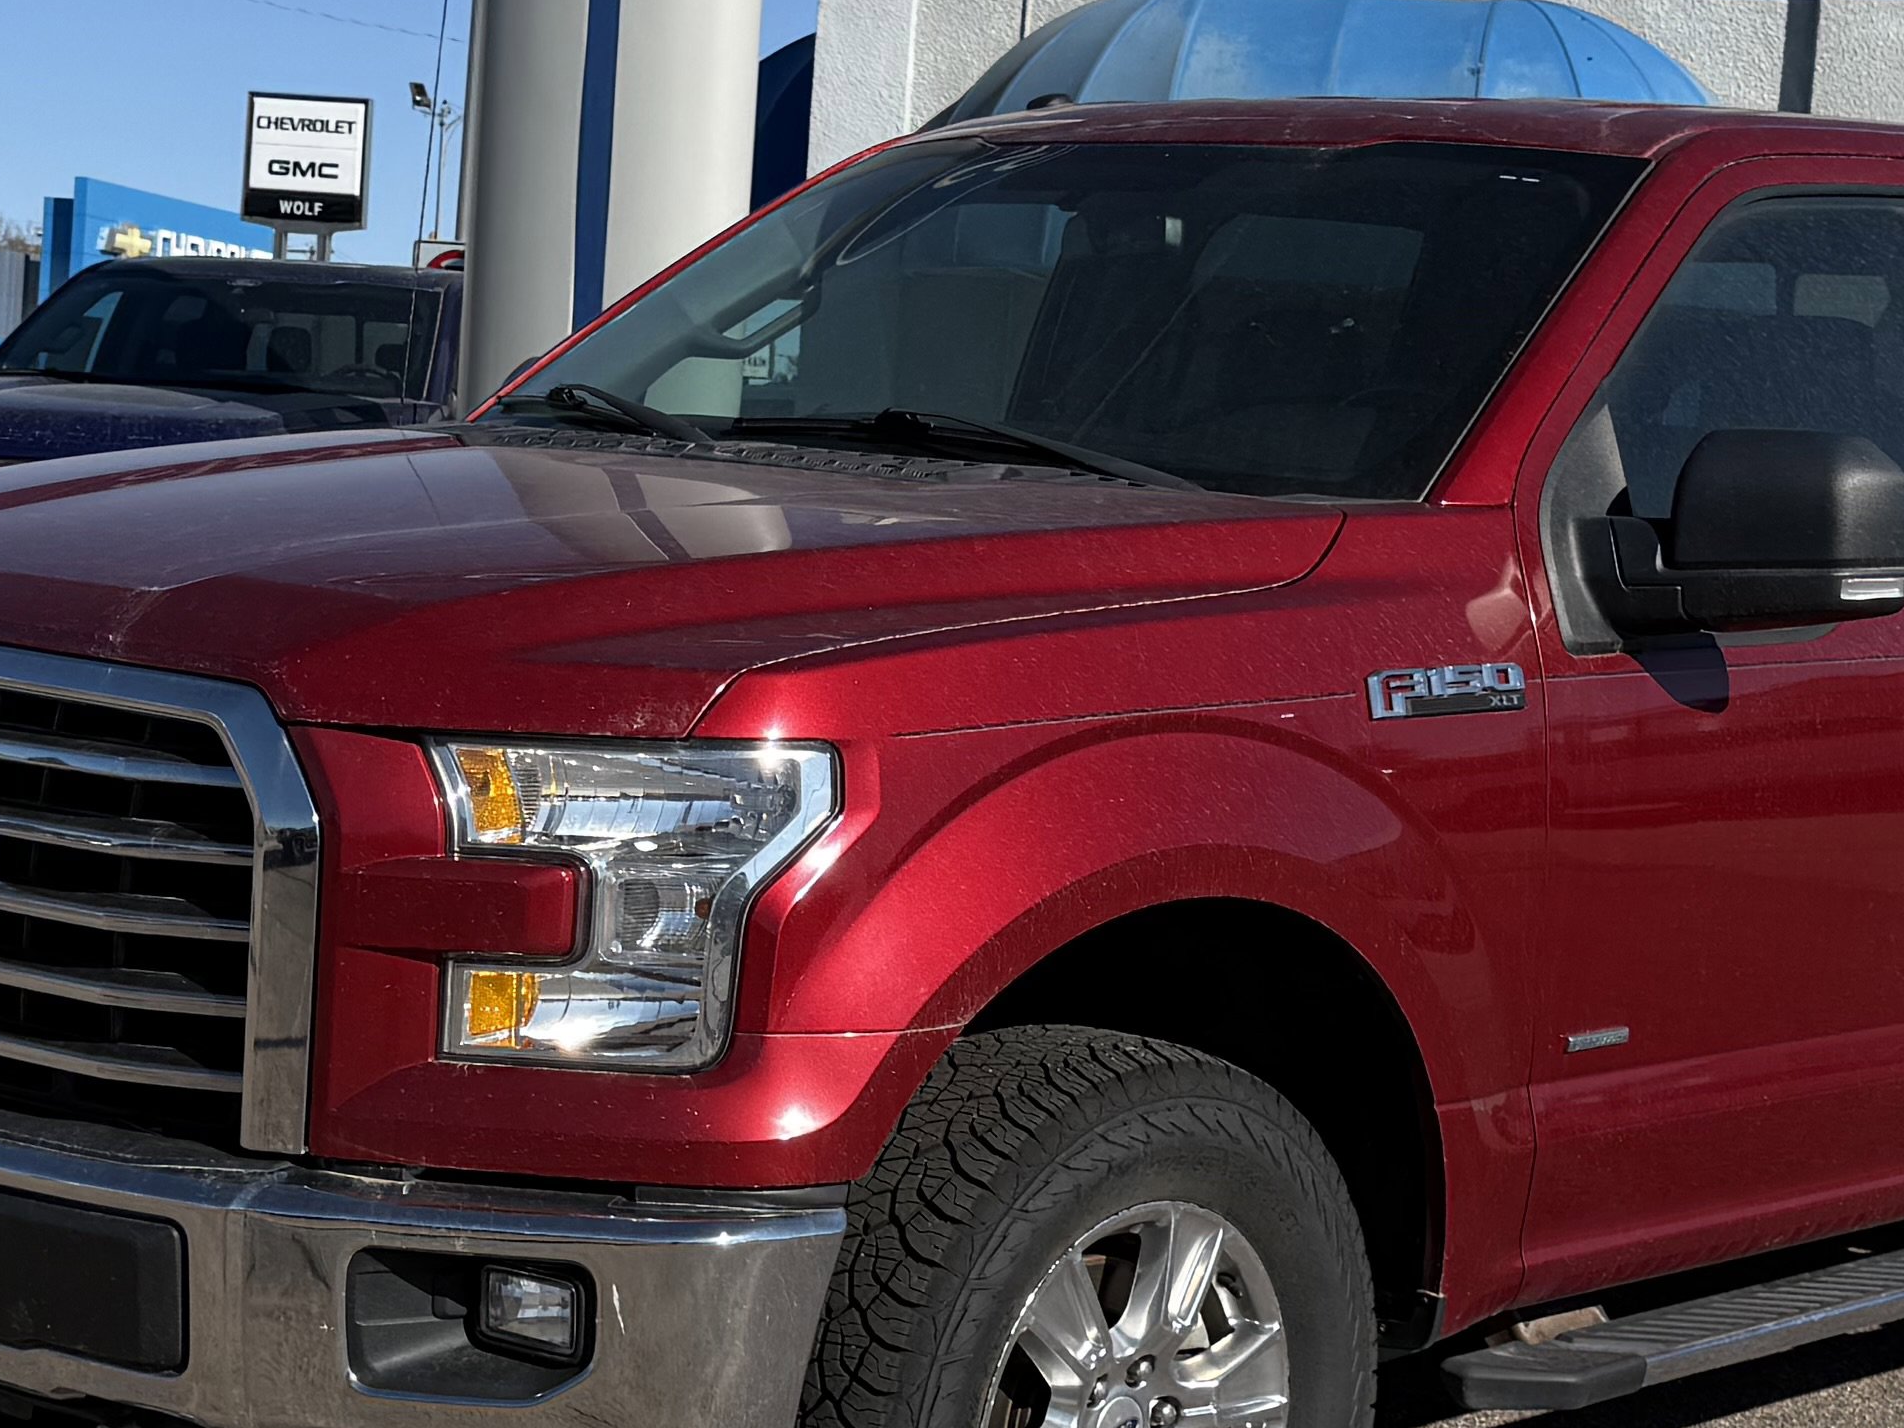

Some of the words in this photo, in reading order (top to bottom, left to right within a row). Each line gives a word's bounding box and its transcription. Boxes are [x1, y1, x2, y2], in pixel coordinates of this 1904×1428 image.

[256, 115, 357, 135] CHEVROLET
[267, 159, 339, 179] GMC
[278, 199, 324, 216] WOLF
[1367, 662, 1526, 720] F150
[1489, 694, 1521, 707] XLT
